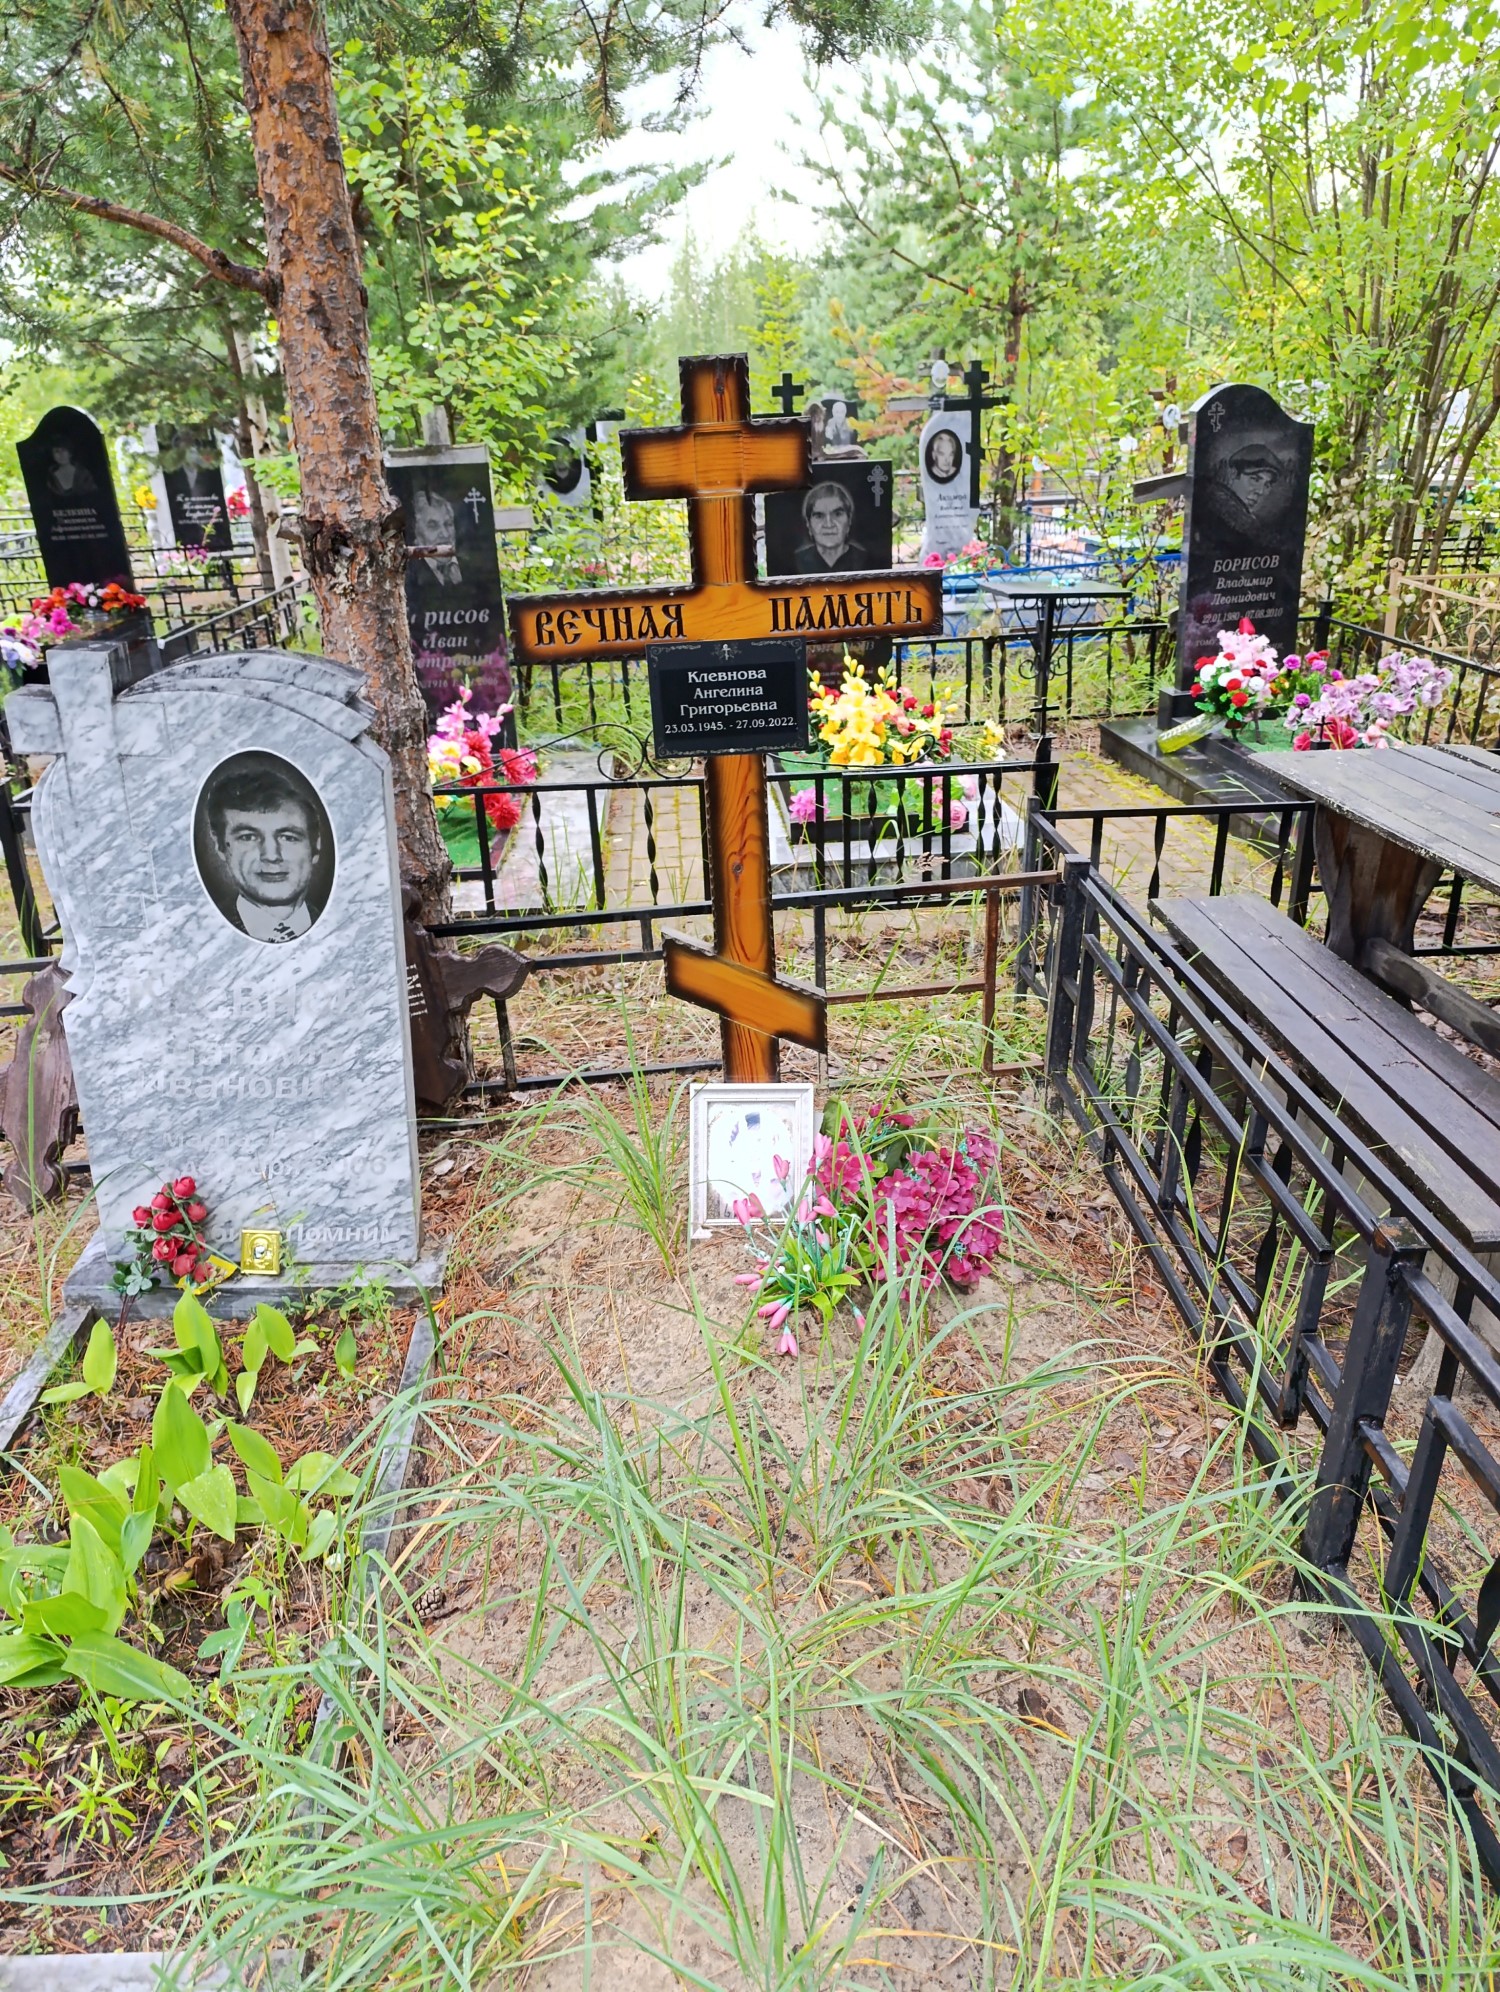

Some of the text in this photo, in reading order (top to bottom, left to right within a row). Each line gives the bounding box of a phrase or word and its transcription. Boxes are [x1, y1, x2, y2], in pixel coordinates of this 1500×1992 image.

[1213, 555, 1280, 573] БОРИСОВ
[1216, 576, 1274, 590] Владимир
[1210, 591, 1276, 606] Леонидович
[411, 608, 490, 631] рисов
[534, 590, 923, 647] ВЕЧНАЯ ПАМЯТЬ
[688, 669, 767, 684] Клевнова
[693, 685, 764, 700] Ангелина
[680, 700, 778, 718] Григорьевна
[664, 722, 727, 734] 23.03.1945.
[735, 716, 798, 730] 27.09.2022.
